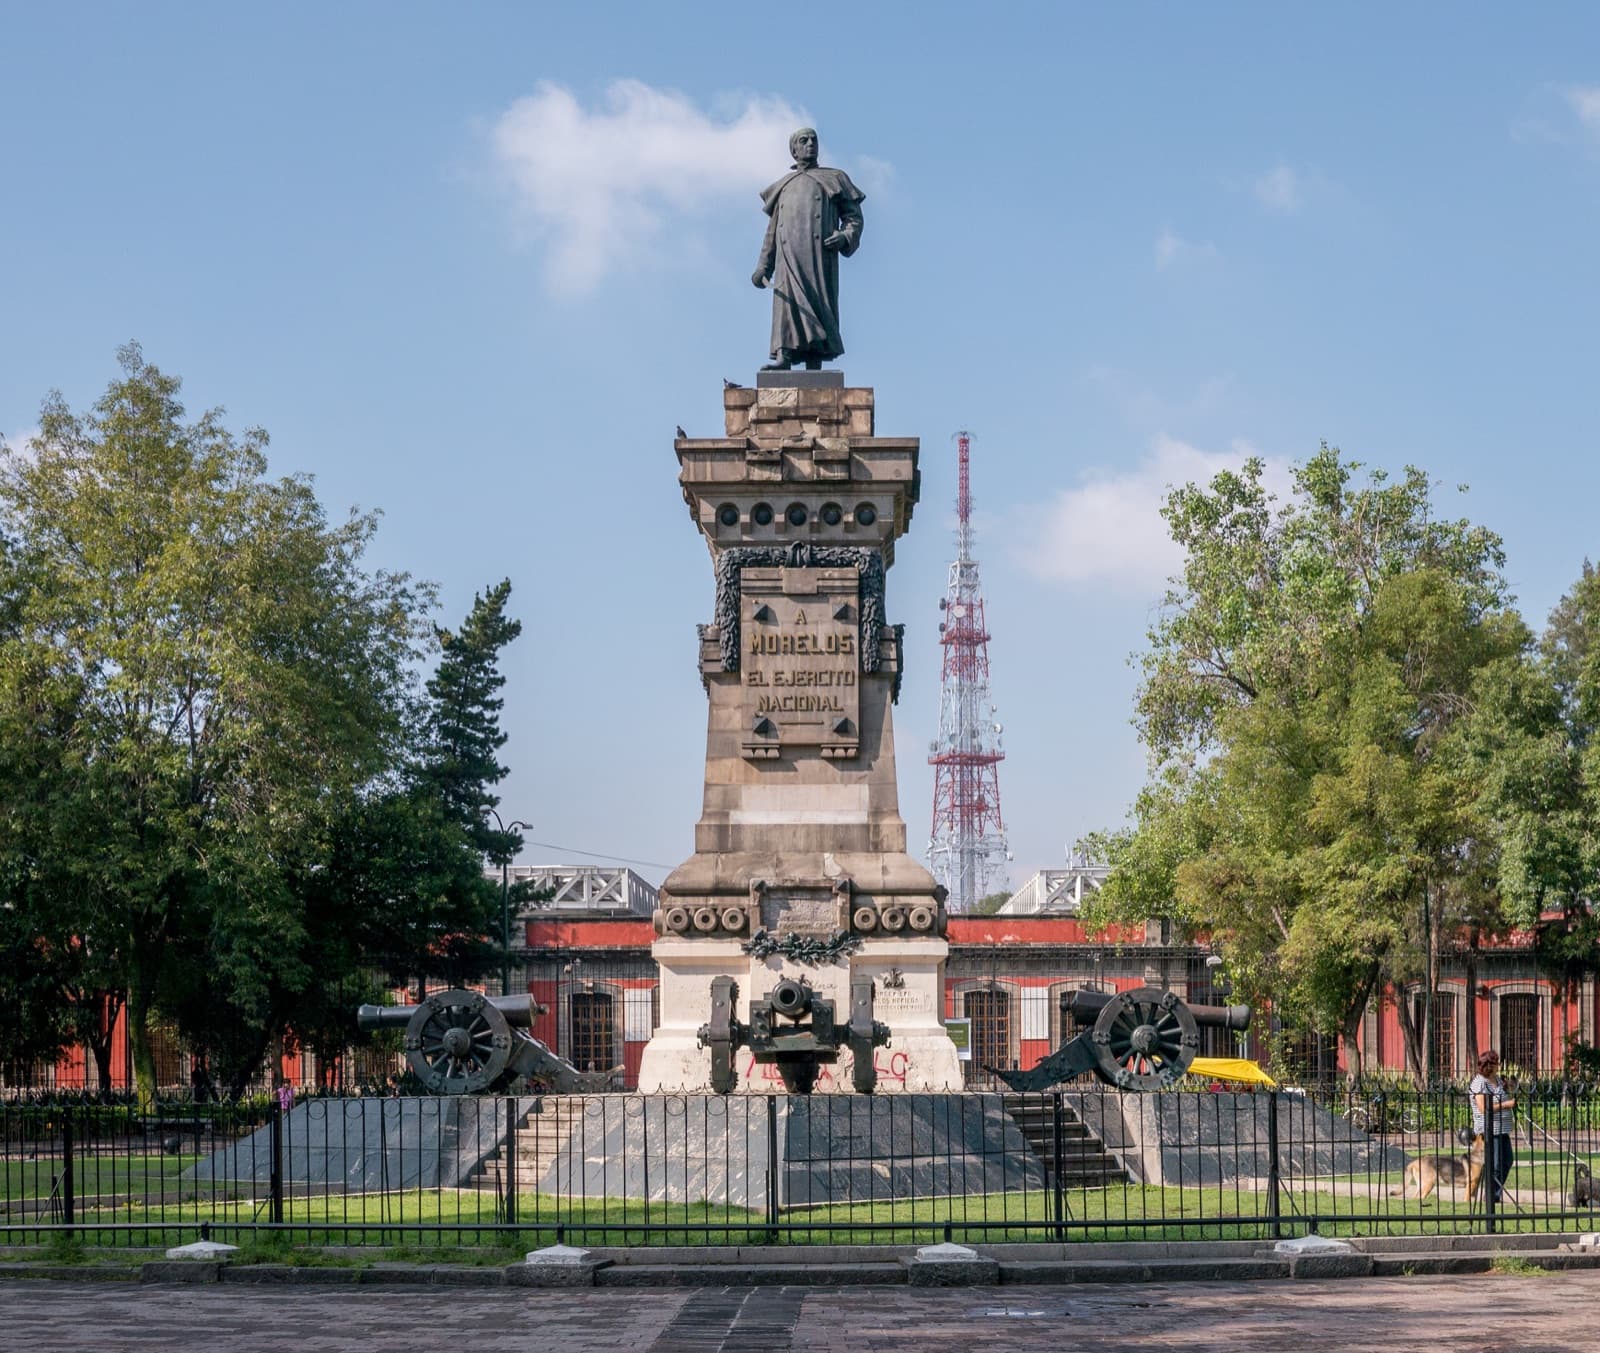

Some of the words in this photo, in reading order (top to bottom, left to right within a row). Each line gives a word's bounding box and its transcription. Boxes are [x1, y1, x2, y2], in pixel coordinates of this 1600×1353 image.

[795, 608, 807, 625] A
[749, 632, 854, 655] MORELOS
[748, 670, 769, 687] EL
[773, 670, 855, 687] EJERCITO
[758, 695, 844, 712] NACIONAL
